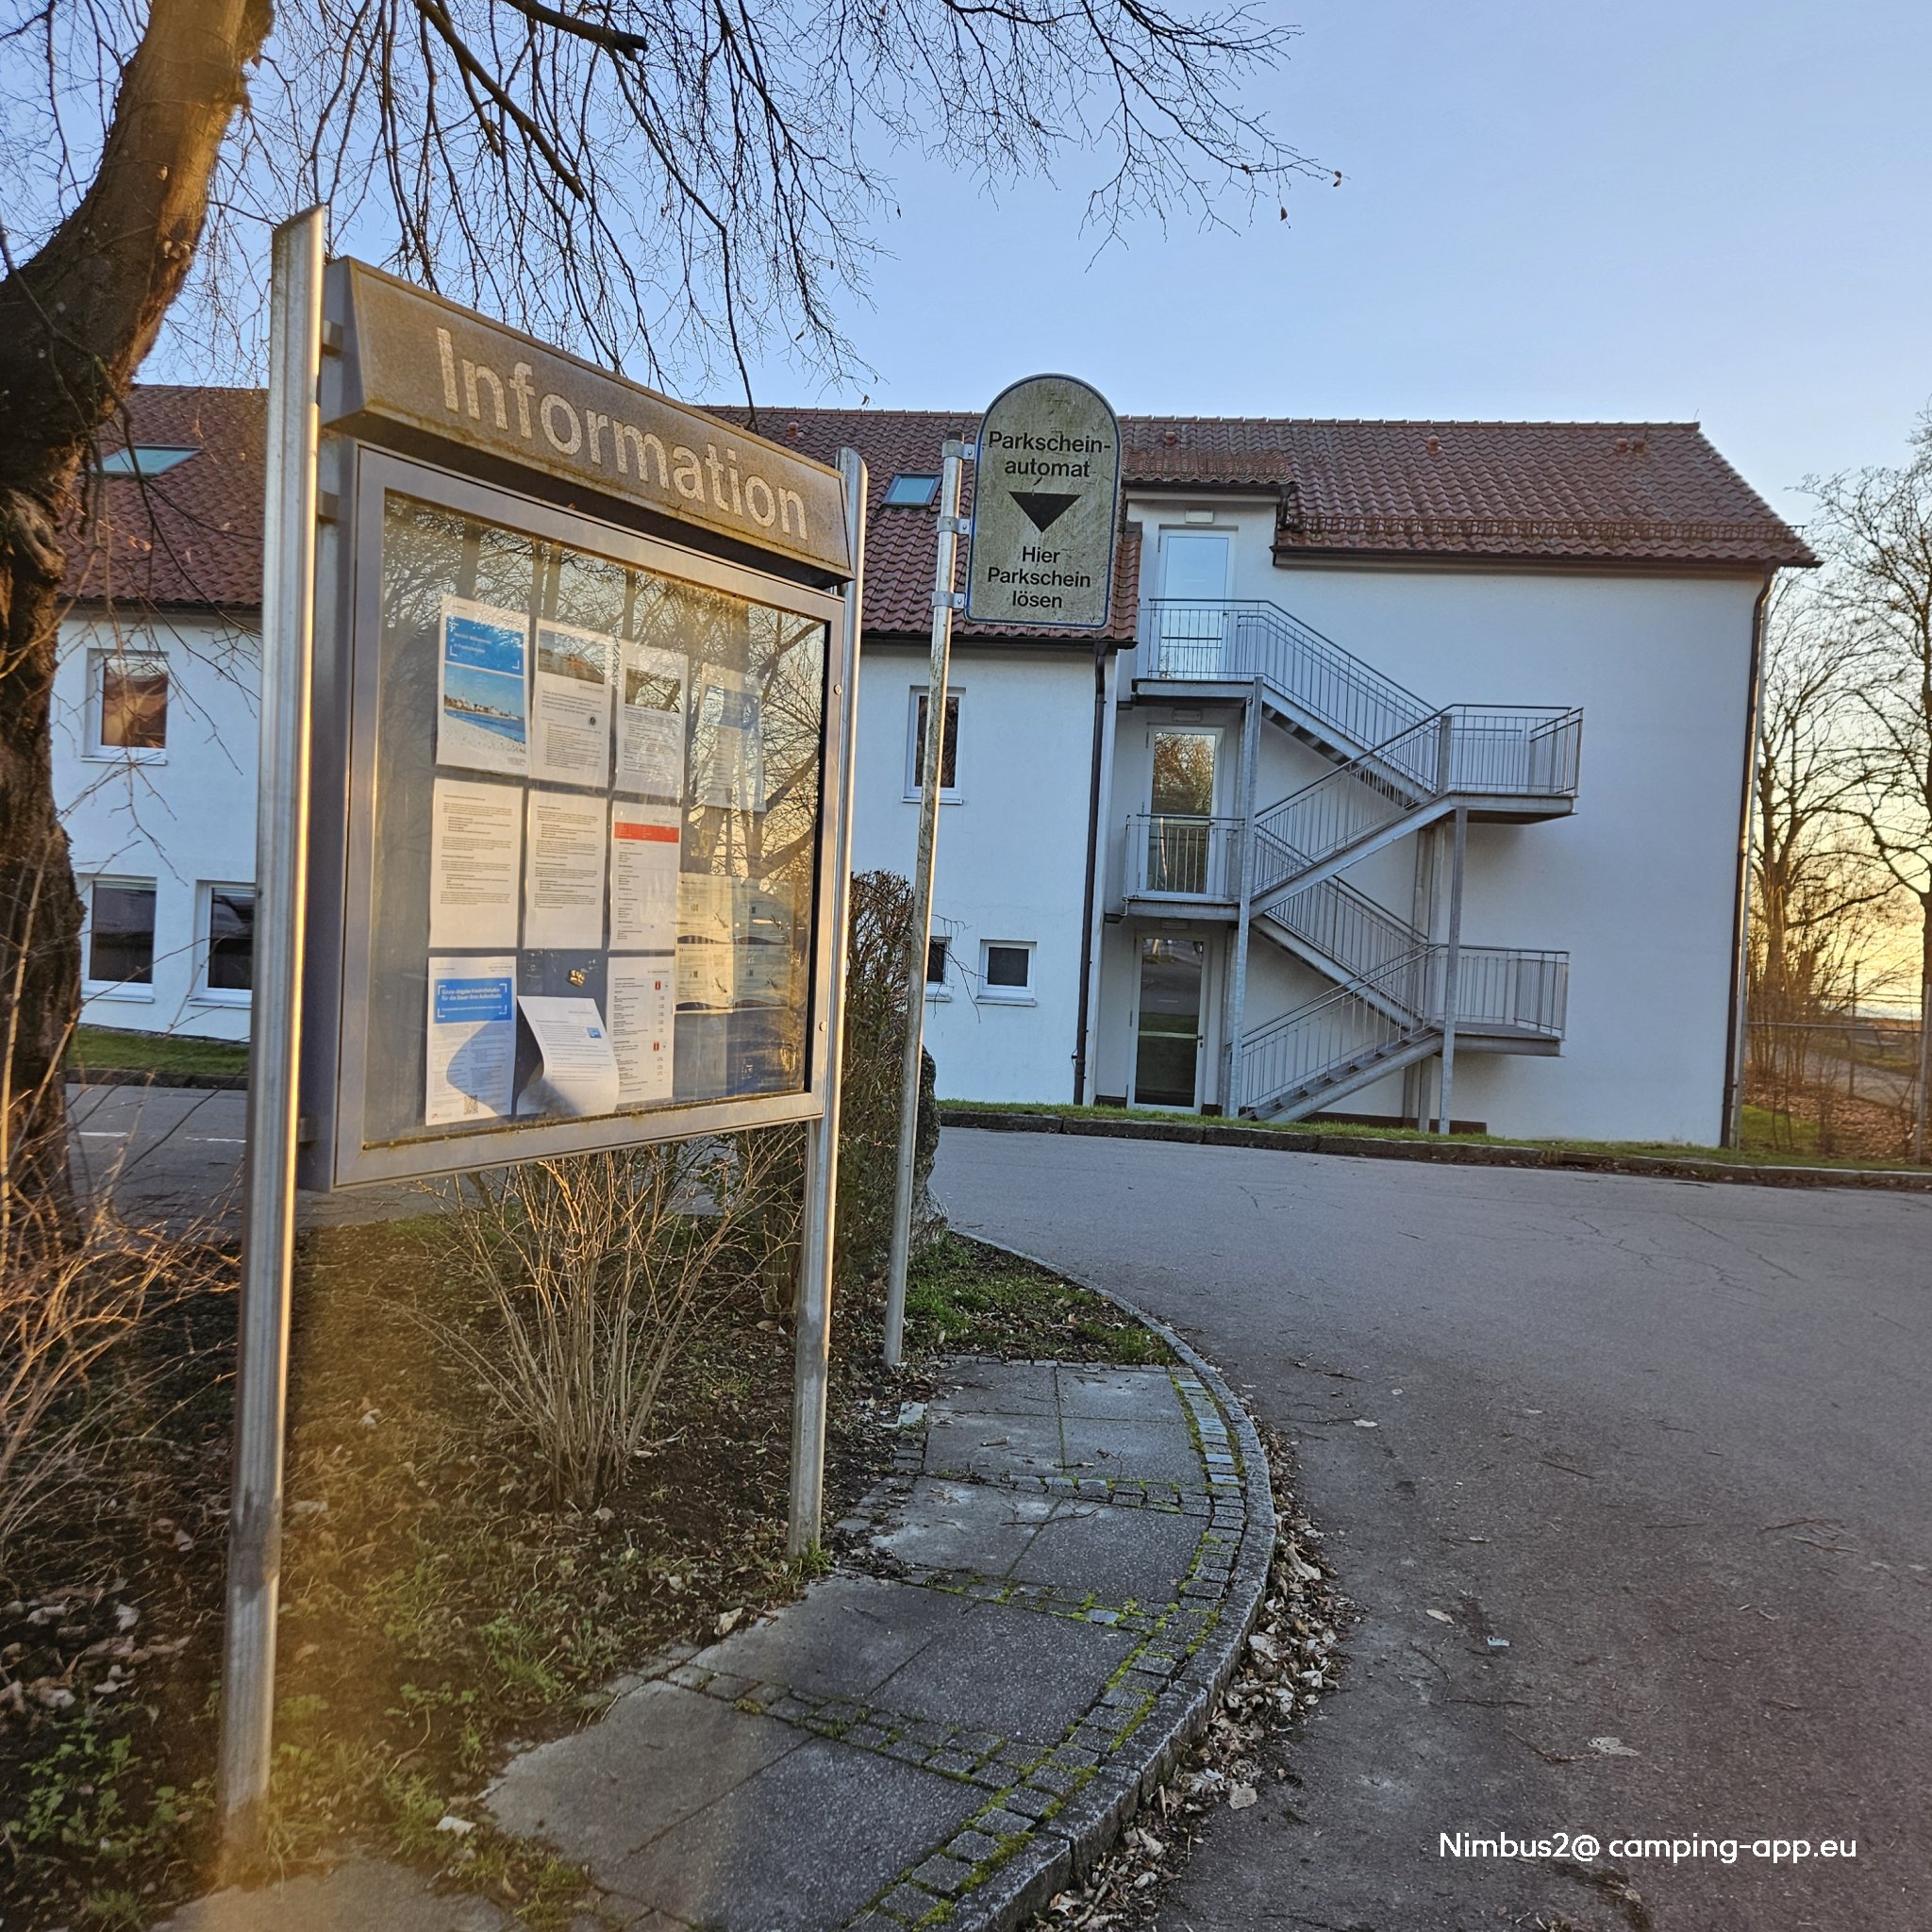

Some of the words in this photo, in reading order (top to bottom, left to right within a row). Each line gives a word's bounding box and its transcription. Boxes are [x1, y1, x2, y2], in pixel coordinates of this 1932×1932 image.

[436, 325, 808, 541] Information
[989, 430, 1111, 454] Parkschein-
[1004, 458, 1090, 477] automat
[1022, 546, 1060, 563] Hier
[988, 567, 1091, 588] Parkschein
[1012, 591, 1062, 608] lösen
